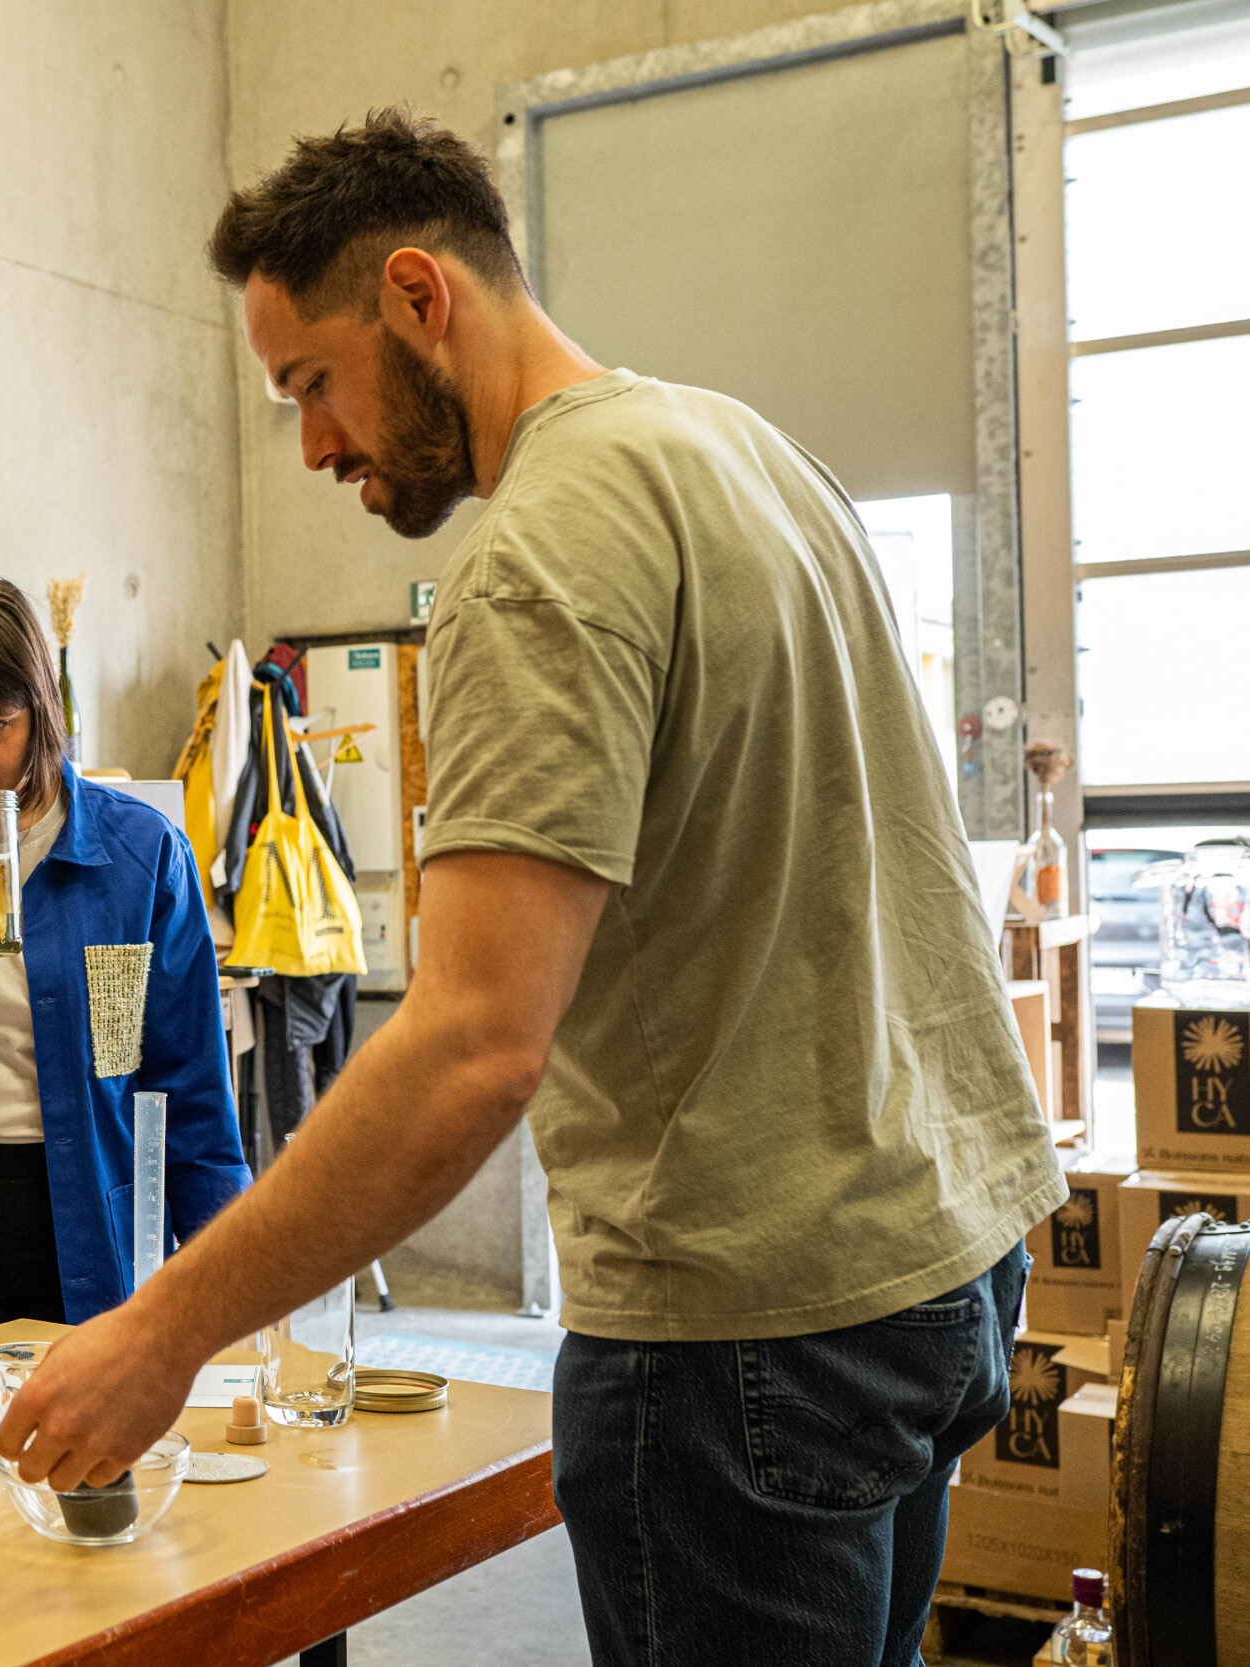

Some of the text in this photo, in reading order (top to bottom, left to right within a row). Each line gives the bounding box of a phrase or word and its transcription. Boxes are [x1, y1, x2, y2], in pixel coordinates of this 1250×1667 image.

[1191, 1076, 1234, 1102] HY
[1191, 1101, 1236, 1129] CA
[1009, 1406, 1049, 1434] HY
[1008, 1431, 1051, 1461] CA
